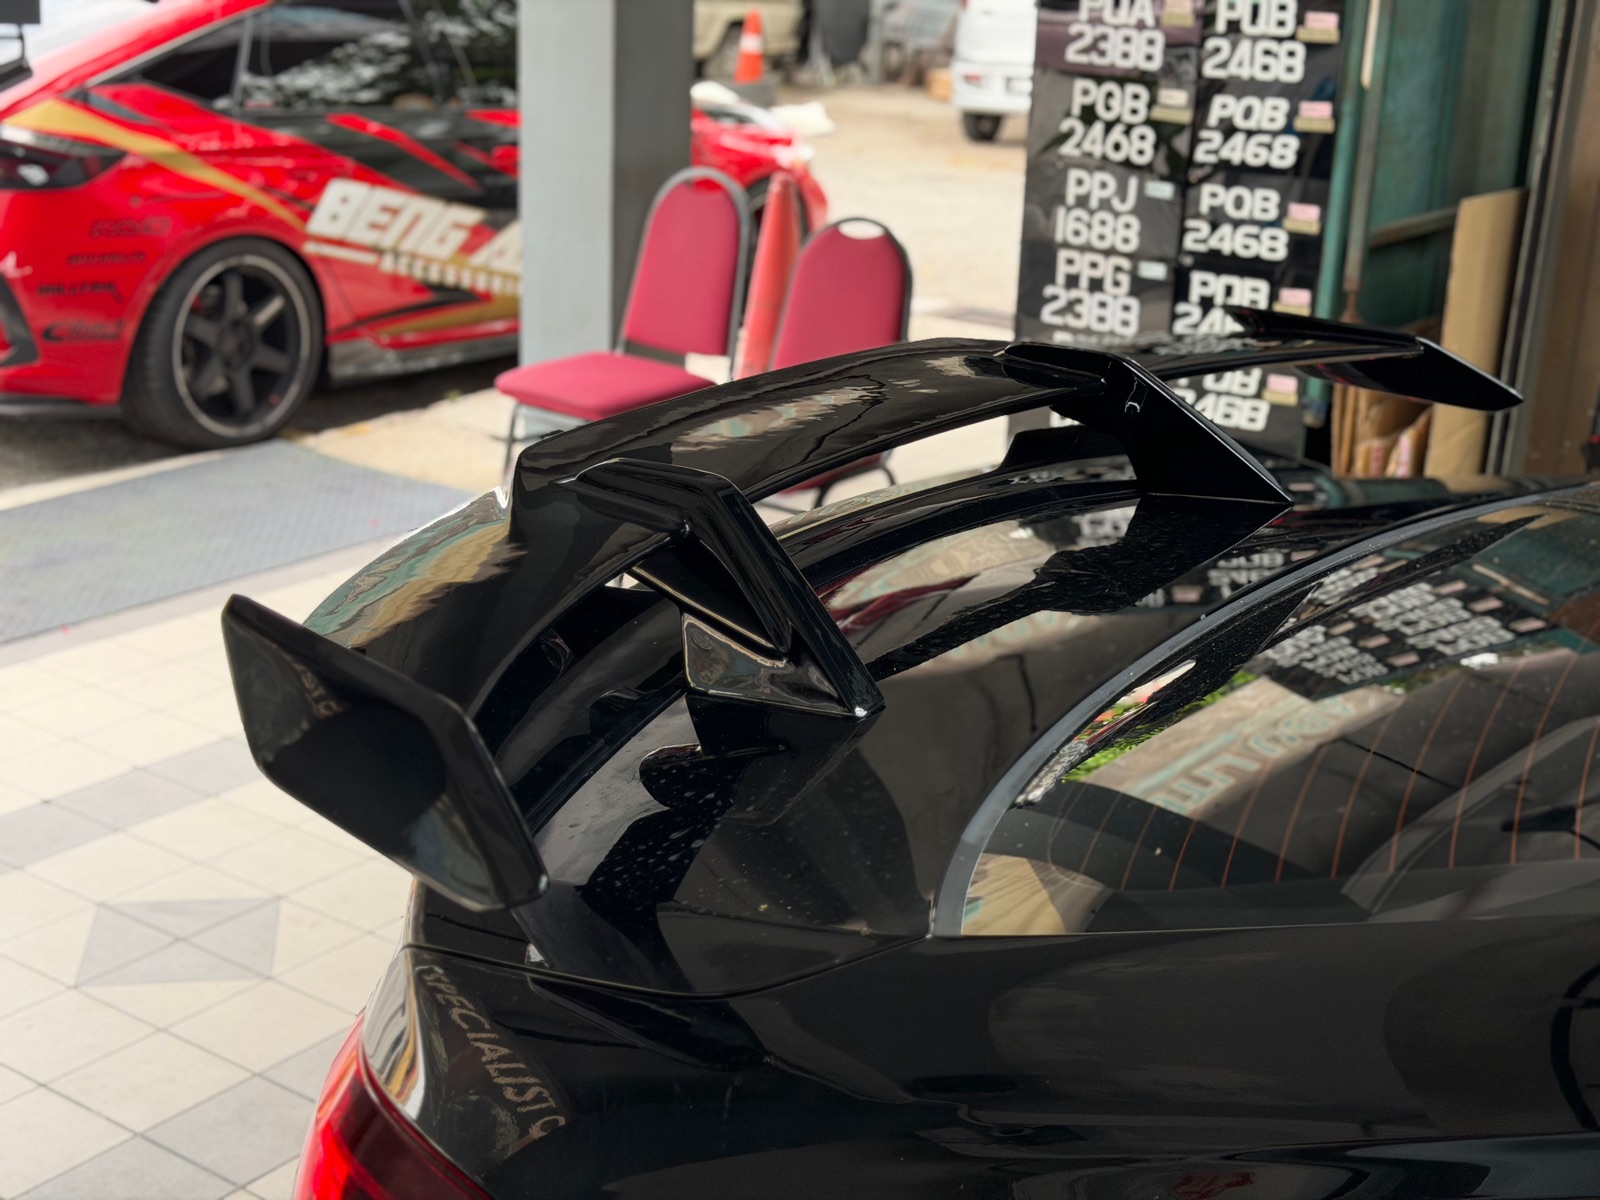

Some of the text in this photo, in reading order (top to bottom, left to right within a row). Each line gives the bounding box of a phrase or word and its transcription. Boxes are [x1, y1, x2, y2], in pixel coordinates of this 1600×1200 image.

[1064, 23, 1165, 72] 2388
[1201, 36, 1306, 84] 2468
[1206, 94, 1290, 132] PQB
[1057, 117, 1157, 166] 2468
[1192, 129, 1300, 169] 2468
[1065, 167, 1139, 213] PPJ
[306, 177, 487, 261] BENG
[1054, 205, 1141, 254] 1688
[1182, 218, 1289, 262] 2468
[1055, 248, 1133, 296] PPG
[1040, 283, 1141, 338] 2388
[1172, 301, 1245, 337] 24
